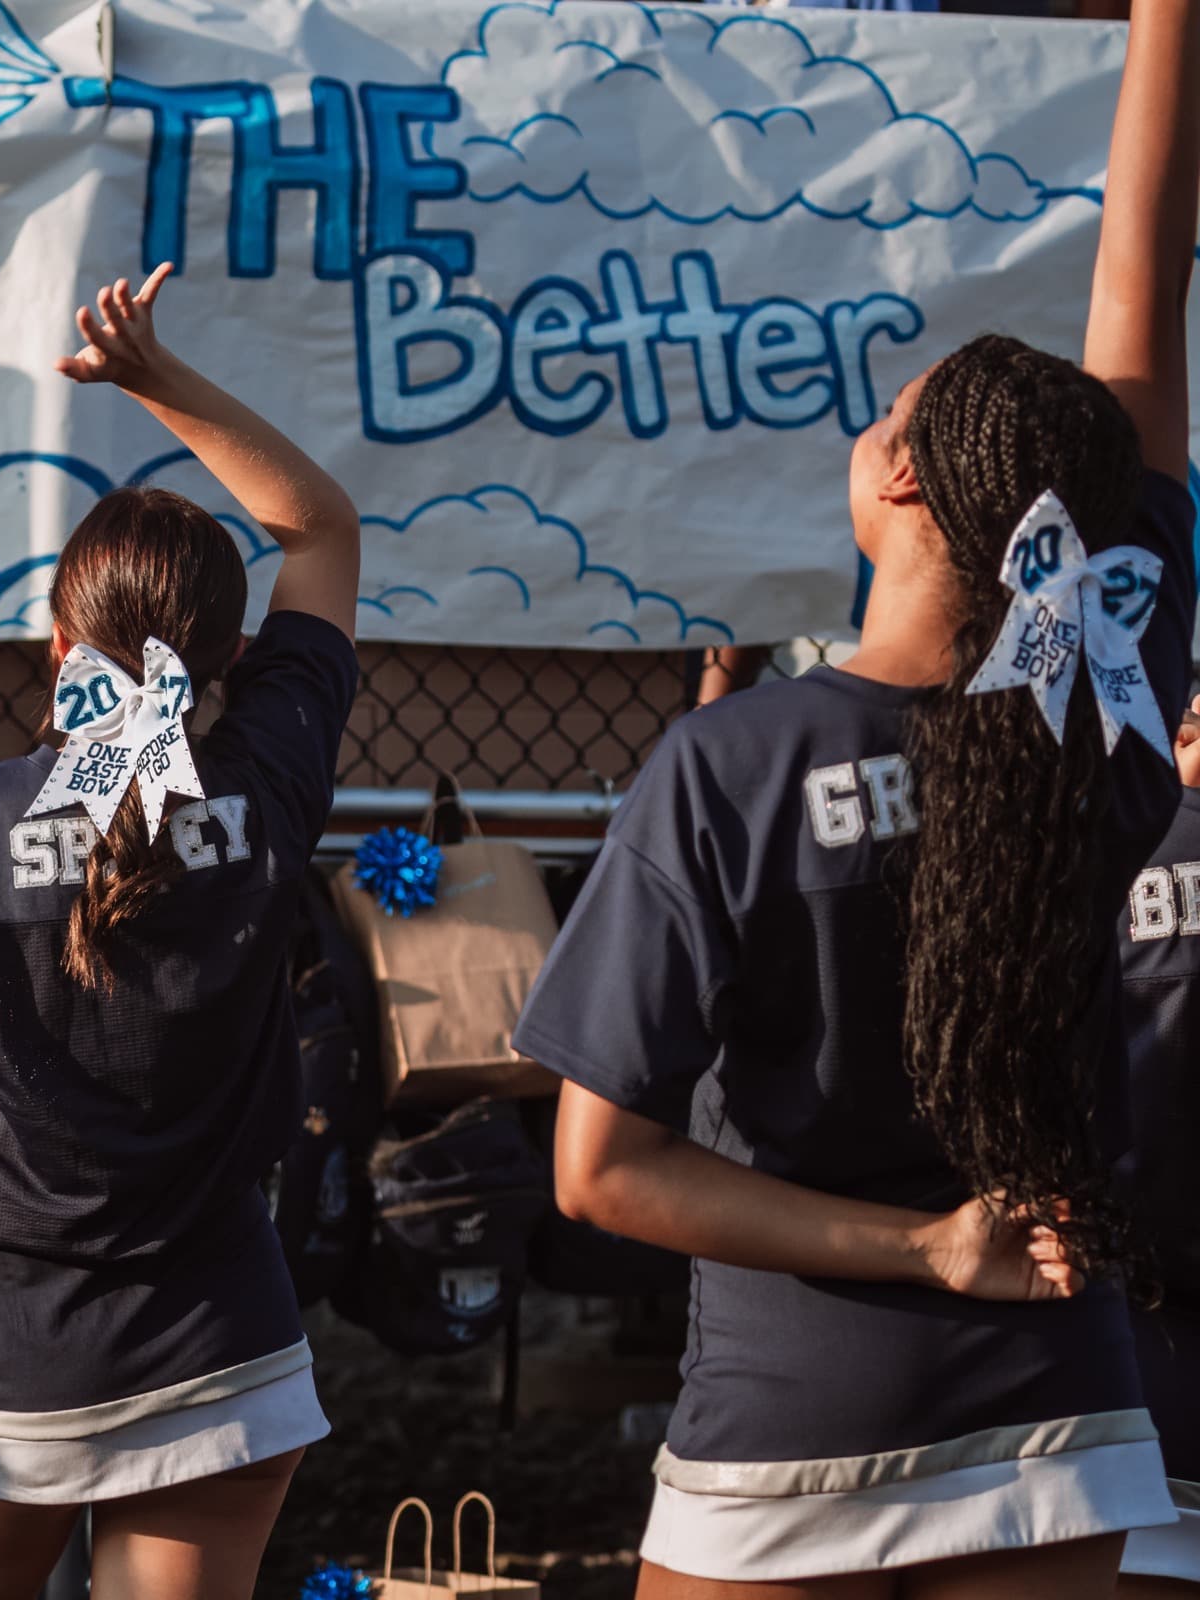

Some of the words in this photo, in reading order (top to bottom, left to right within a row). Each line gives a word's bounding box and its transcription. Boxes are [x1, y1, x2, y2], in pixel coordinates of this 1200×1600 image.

[63, 74, 476, 281] THE
[354, 245, 925, 444] Better
[1013, 524, 1063, 594] 20
[1018, 623, 1075, 668] LAST
[1034, 605, 1077, 645] ONE
[1011, 648, 1064, 688] BOW
[58, 674, 121, 731] 20
[73, 756, 128, 781] LAST
[87, 742, 131, 764] ONE
[136, 723, 180, 775] BEFORE
[153, 752, 171, 778] GO
[66, 774, 119, 797] BOW
